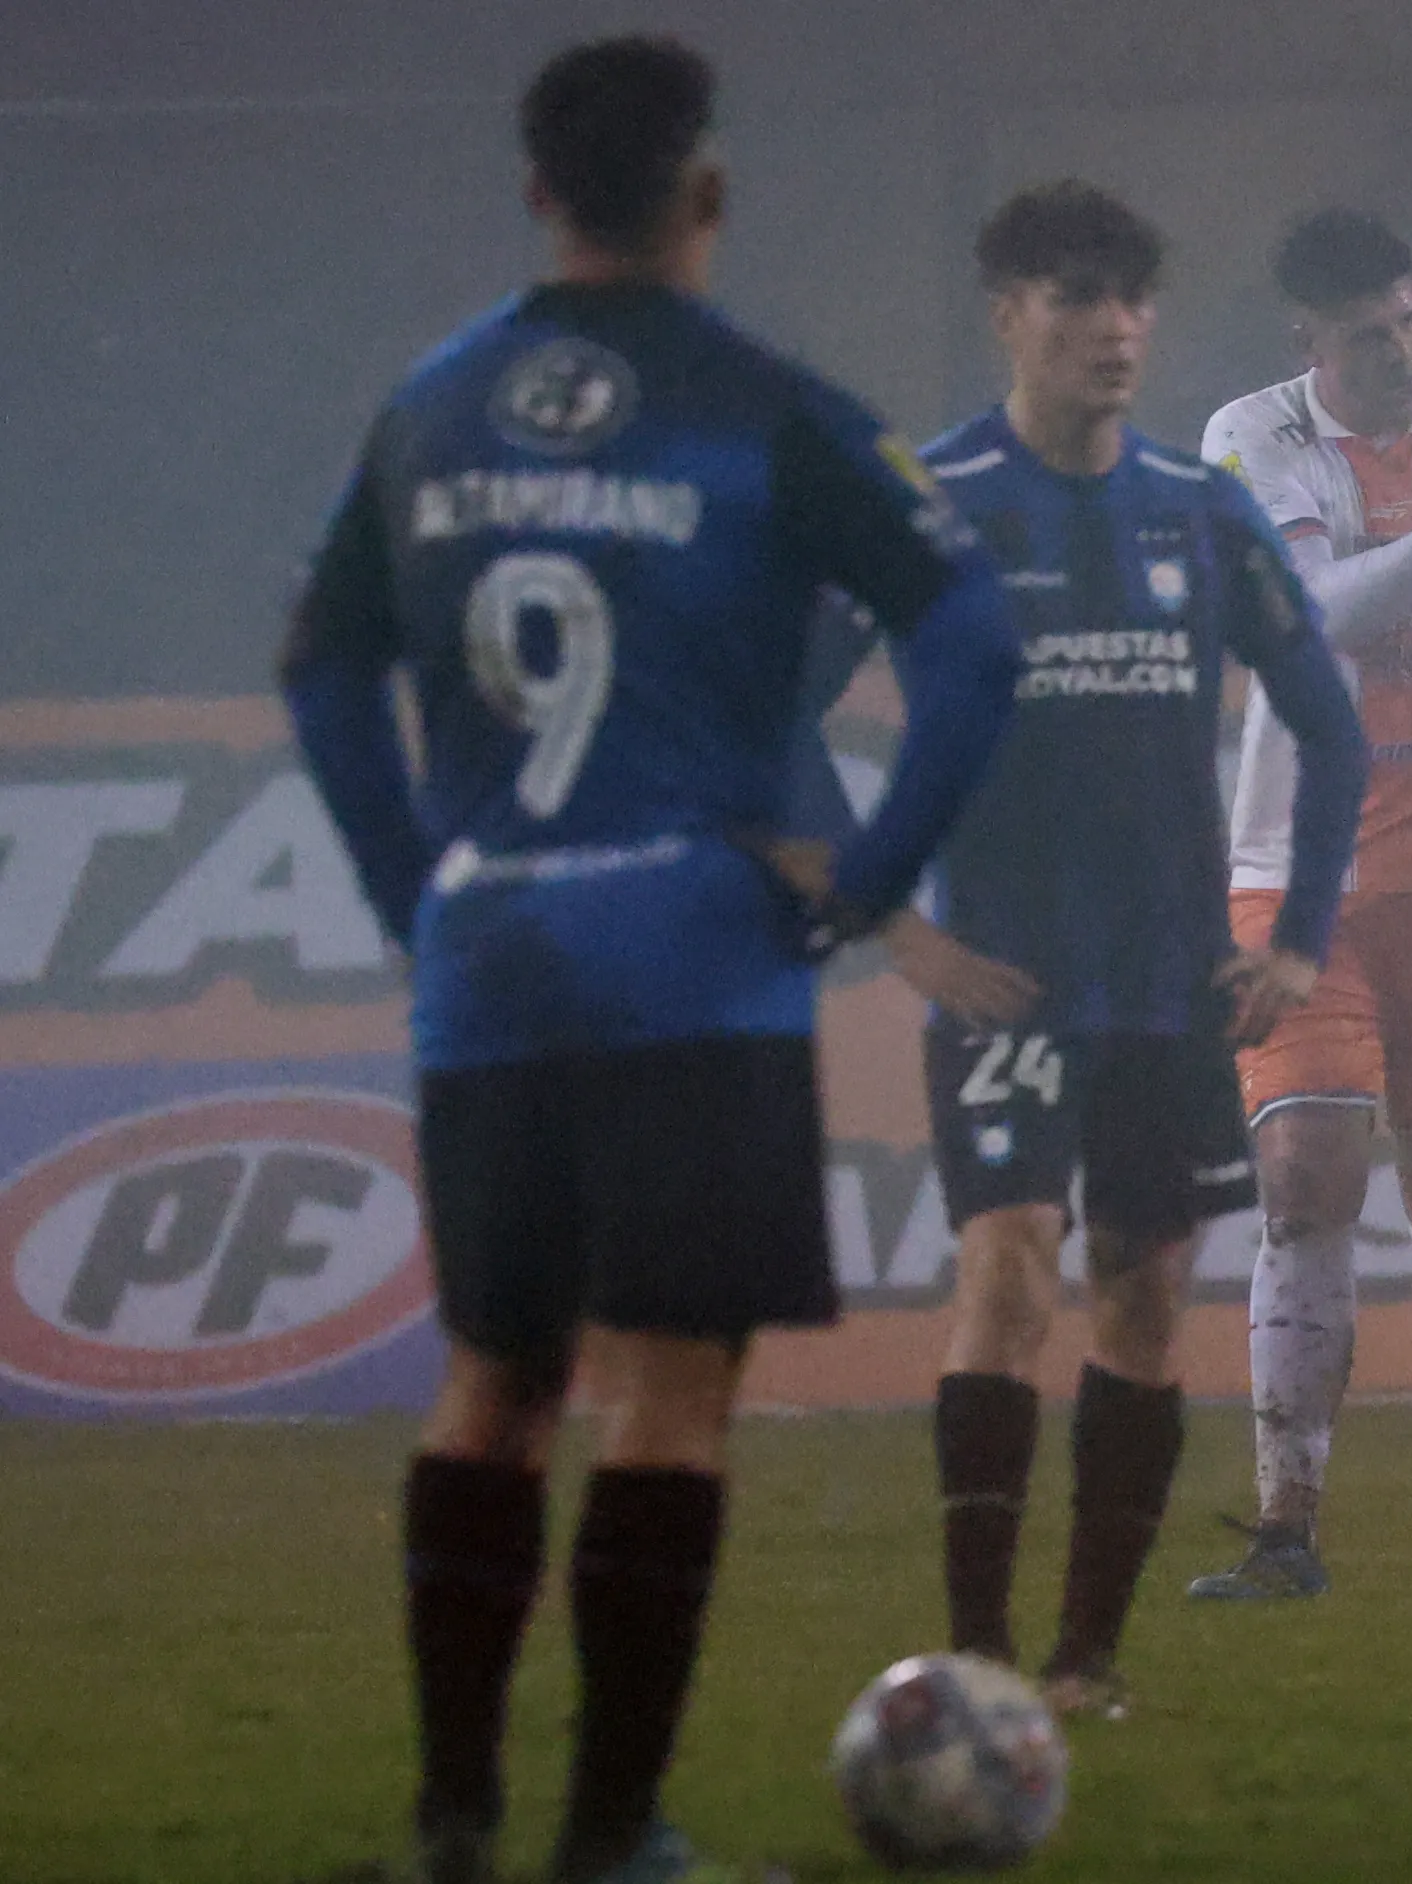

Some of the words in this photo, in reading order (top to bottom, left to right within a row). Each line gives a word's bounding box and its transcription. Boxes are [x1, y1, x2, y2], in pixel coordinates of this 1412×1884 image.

[464, 550, 614, 819] 9
[957, 1031, 1062, 1105] 24
[62, 1150, 374, 1335] PF
